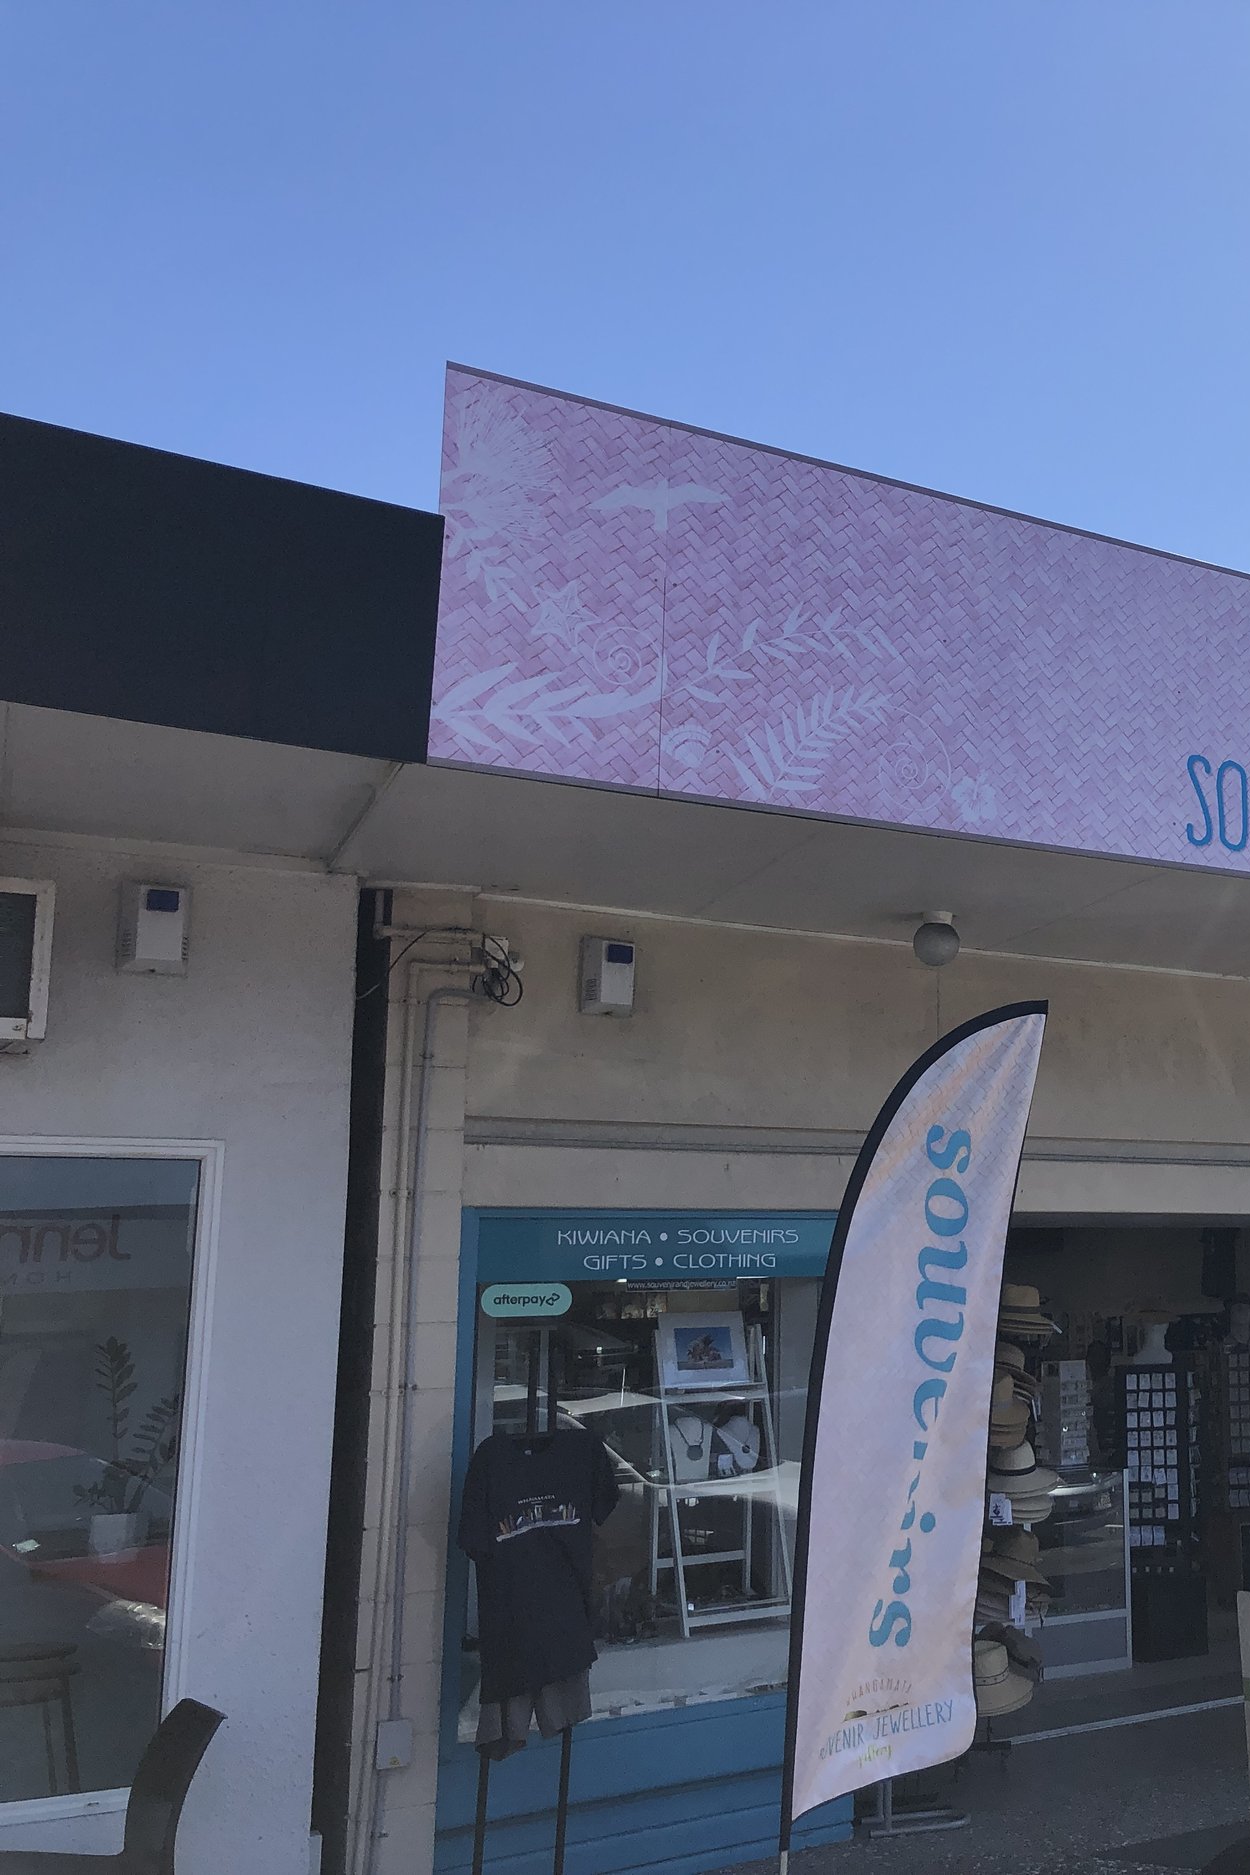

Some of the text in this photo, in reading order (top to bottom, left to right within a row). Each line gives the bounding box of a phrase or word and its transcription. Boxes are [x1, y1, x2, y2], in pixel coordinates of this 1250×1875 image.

[557, 1229, 799, 1245] KIWIANA SOUVENIRS
[583, 1253, 776, 1270] GIFTS CLOTHING
[493, 1293, 546, 1307] afterpay
[873, 1699, 954, 1740] JEWELLERY
